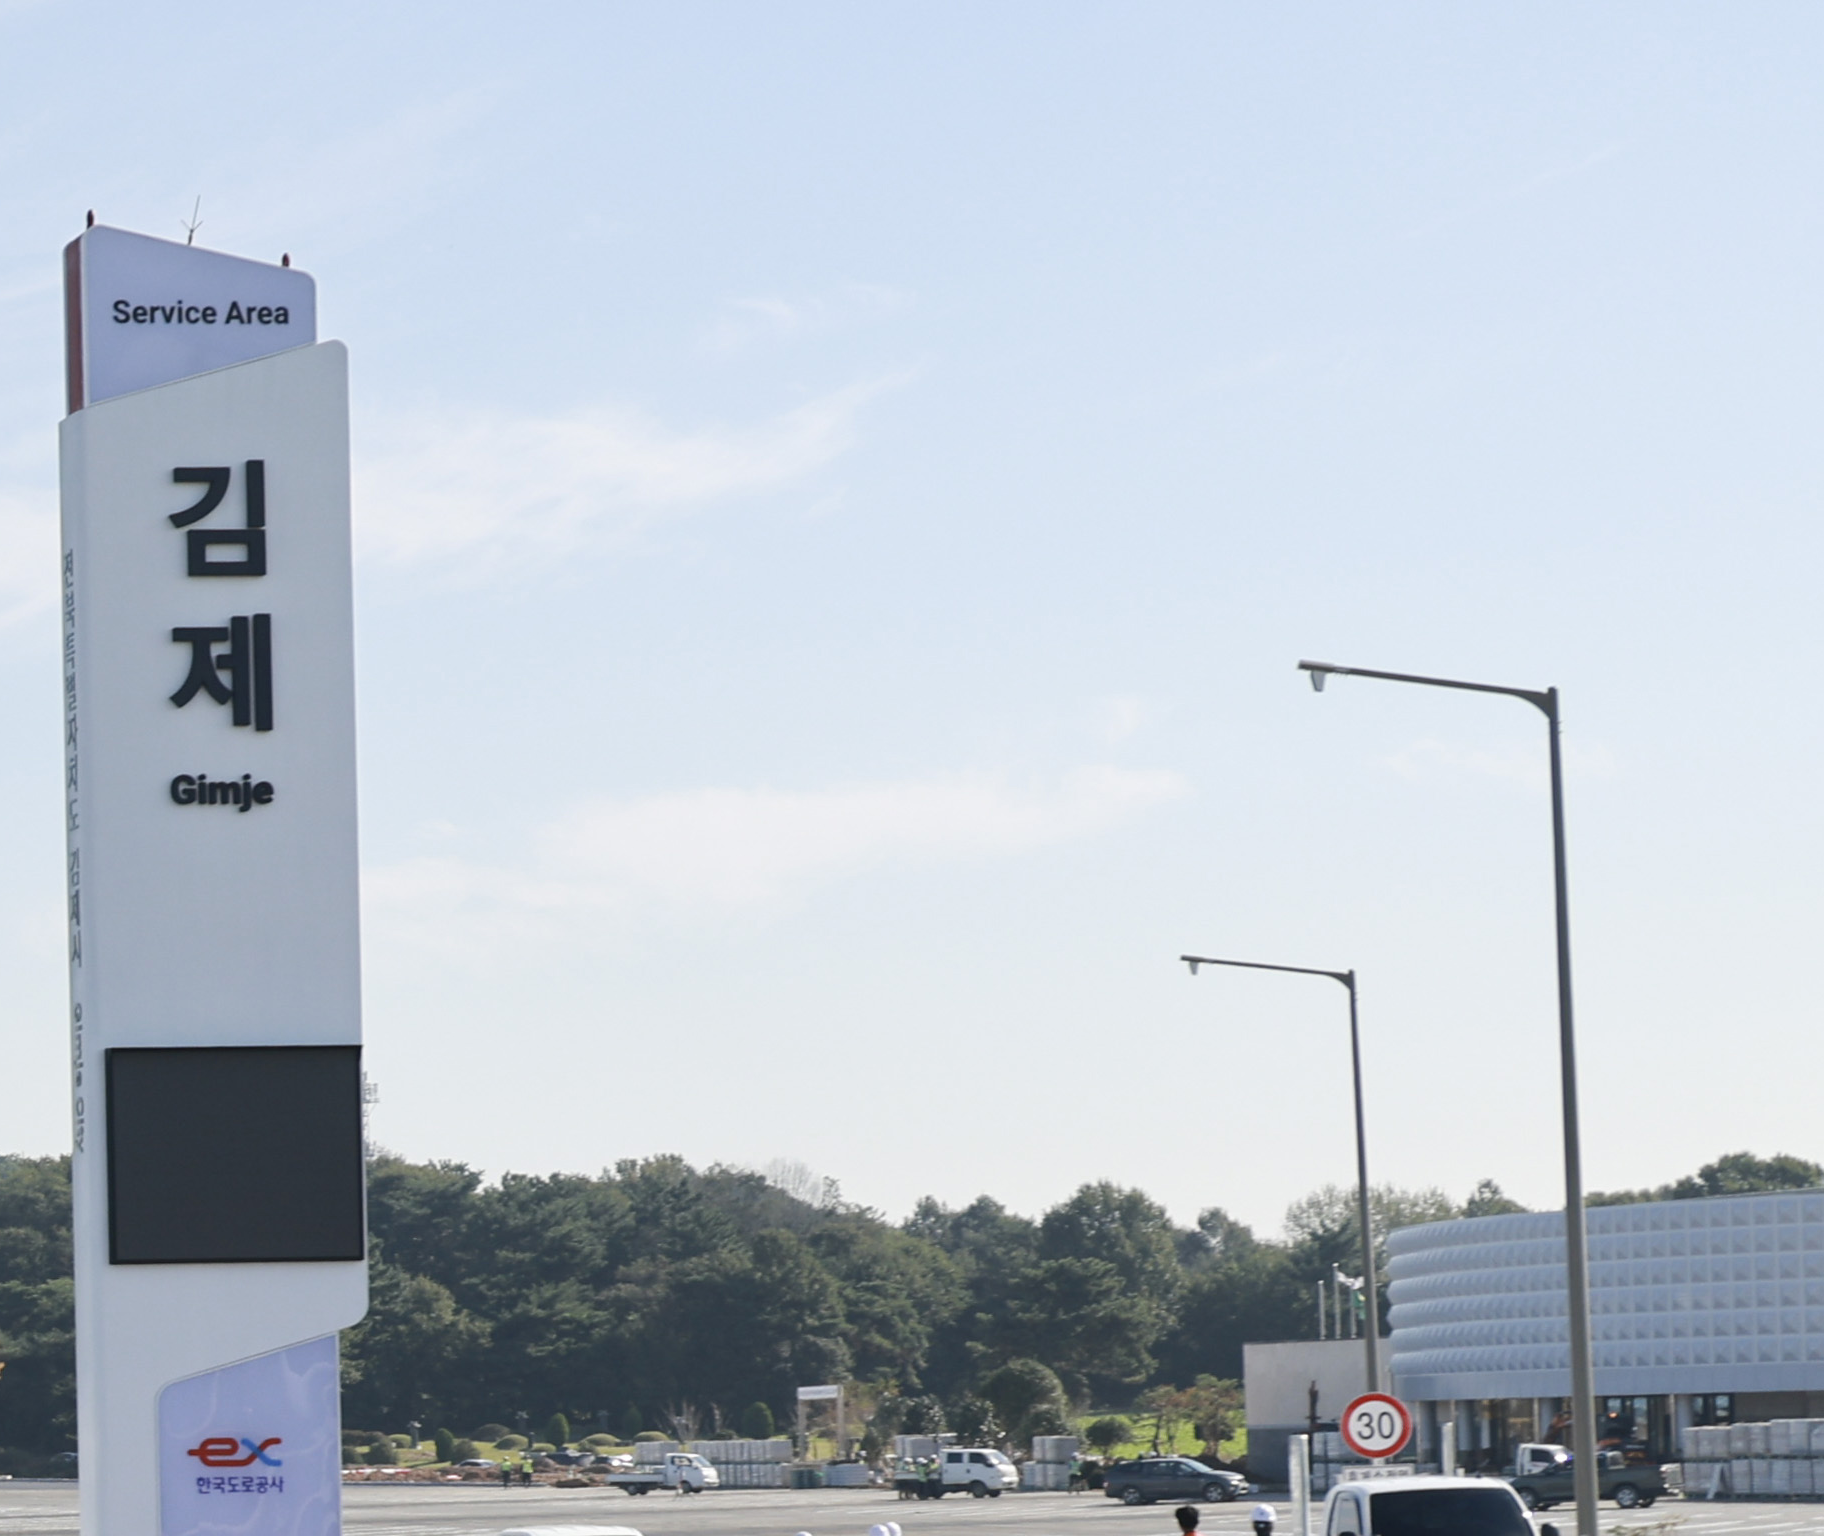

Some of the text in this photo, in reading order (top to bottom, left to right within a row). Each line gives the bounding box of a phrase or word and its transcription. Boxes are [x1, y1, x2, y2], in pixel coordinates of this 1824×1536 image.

[113, 299, 289, 324] Service Area
[168, 459, 273, 731] 김제
[170, 774, 274, 812] Gimje
[1357, 1411, 1395, 1440] 30
[187, 1437, 283, 1468] ex
[196, 1476, 285, 1494] 한국도로공사
